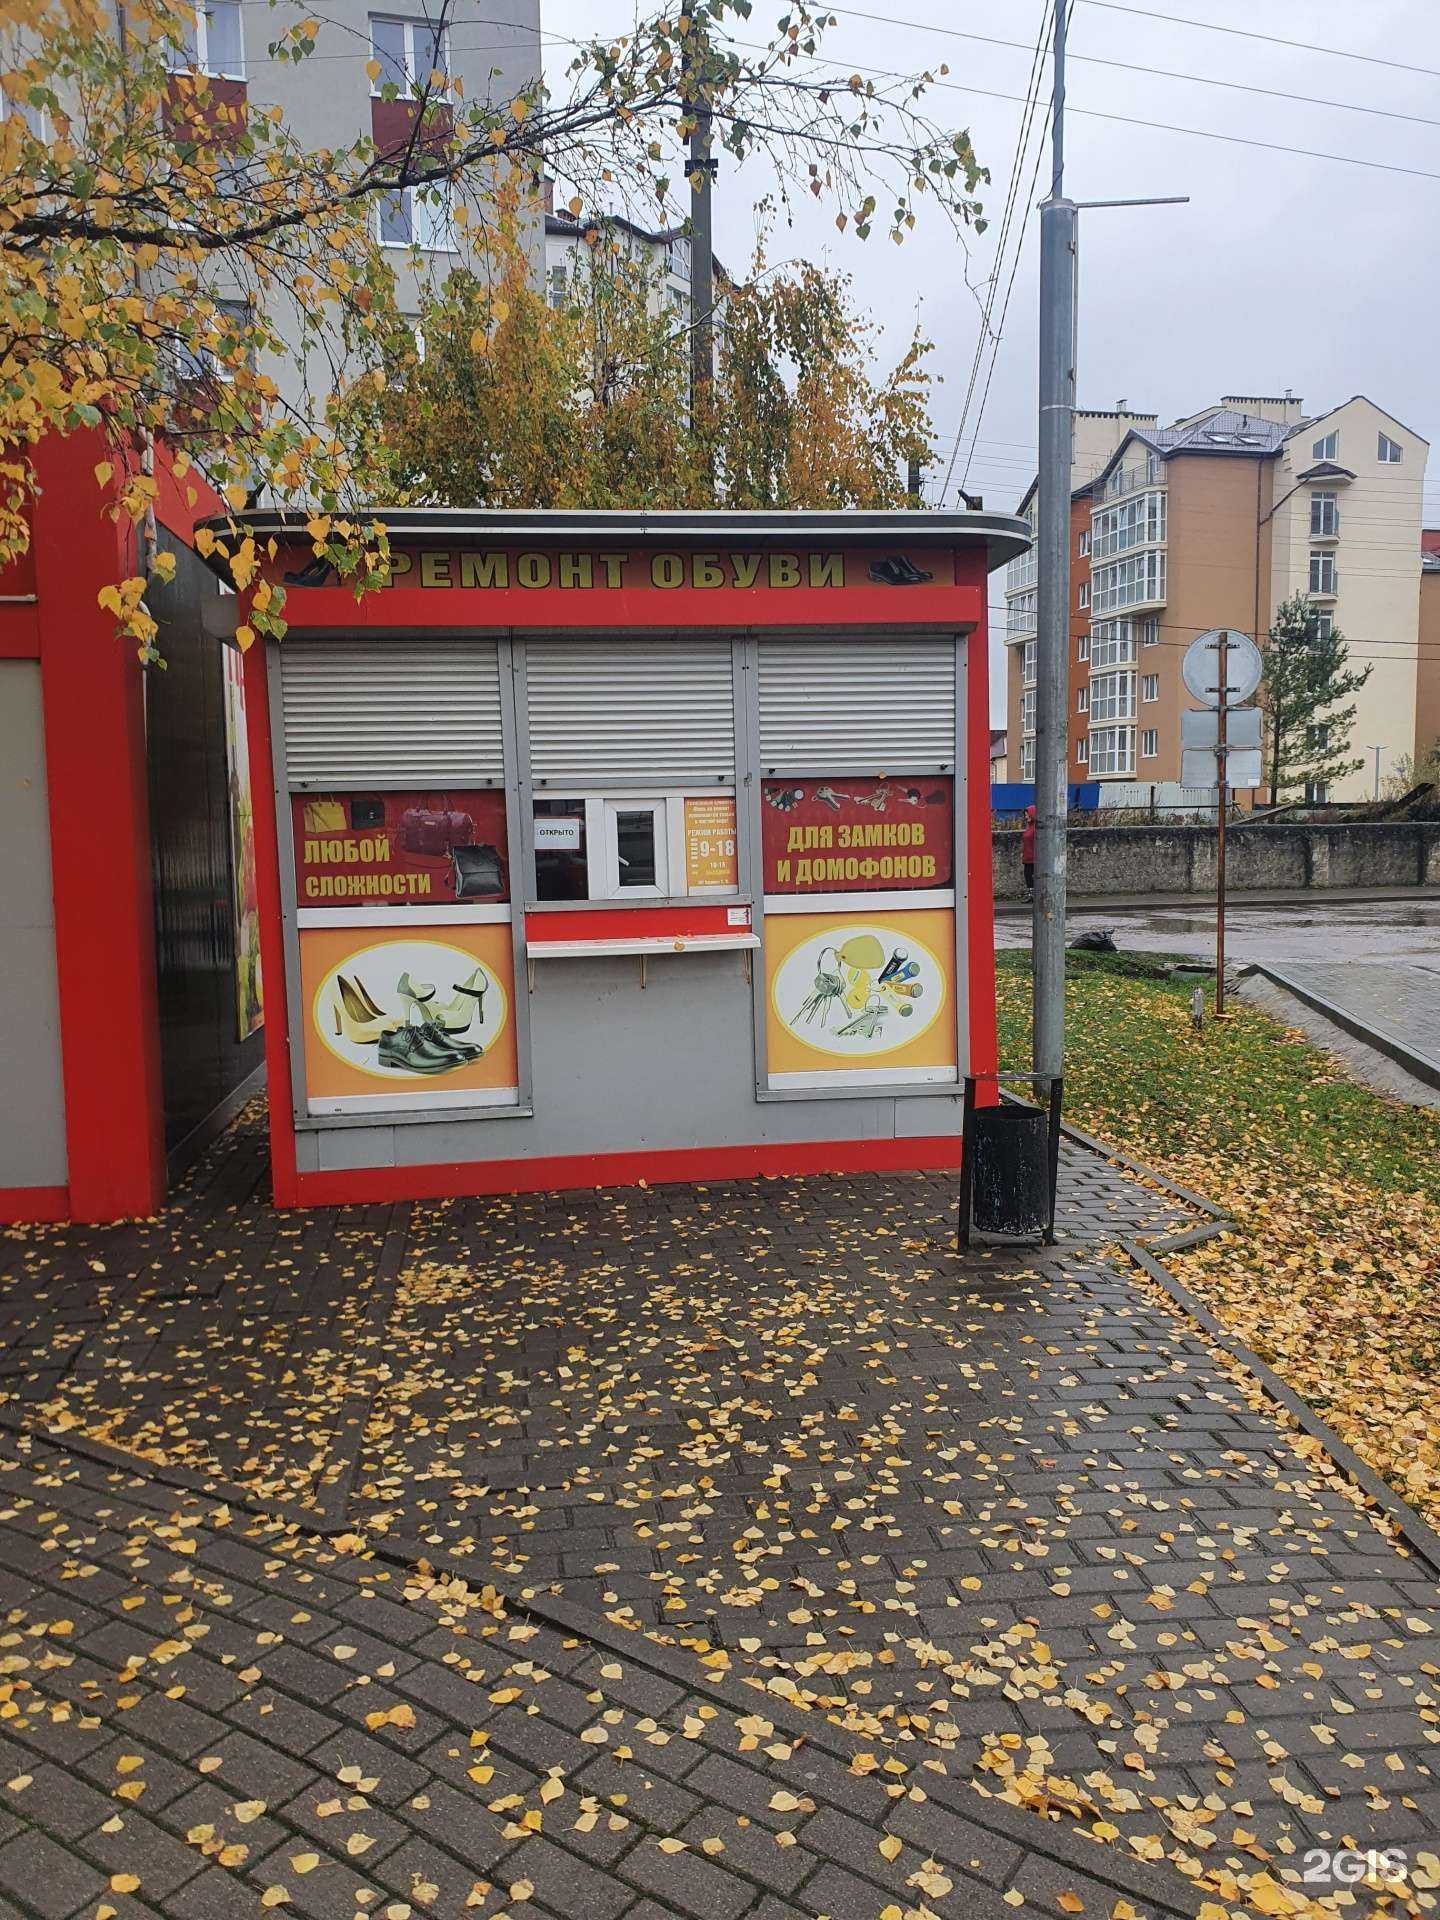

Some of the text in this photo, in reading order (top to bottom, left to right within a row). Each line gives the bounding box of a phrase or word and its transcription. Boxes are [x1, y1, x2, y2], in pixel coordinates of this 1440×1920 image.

[381, 551, 846, 589] РЕМОНТ ОБУВИ
[303, 834, 390, 863] ЛЮБОЙ
[700, 840, 734, 857] 9-18
[787, 823, 925, 852] ДЛЯ ЗАМКОВ
[777, 855, 936, 885] И ДОМОФОНОВ
[305, 873, 431, 897] СЛОЖНОСТИ
